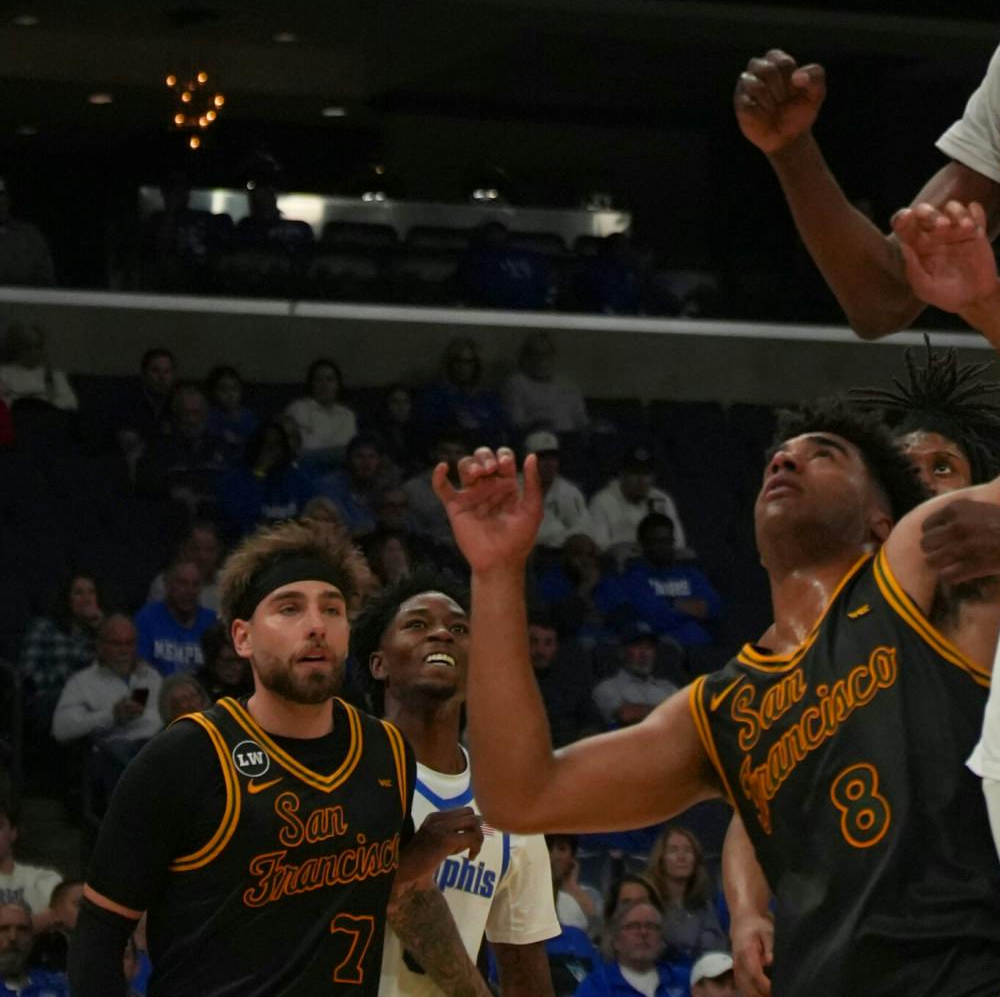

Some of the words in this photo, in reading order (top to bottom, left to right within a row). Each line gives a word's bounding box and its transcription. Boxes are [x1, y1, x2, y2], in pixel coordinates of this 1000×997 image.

[731, 668, 807, 751] San
[237, 752, 263, 766] LW
[275, 792, 347, 847] San
[830, 763, 891, 848] 8
[434, 857, 496, 898] phis
[331, 912, 374, 984] 7
